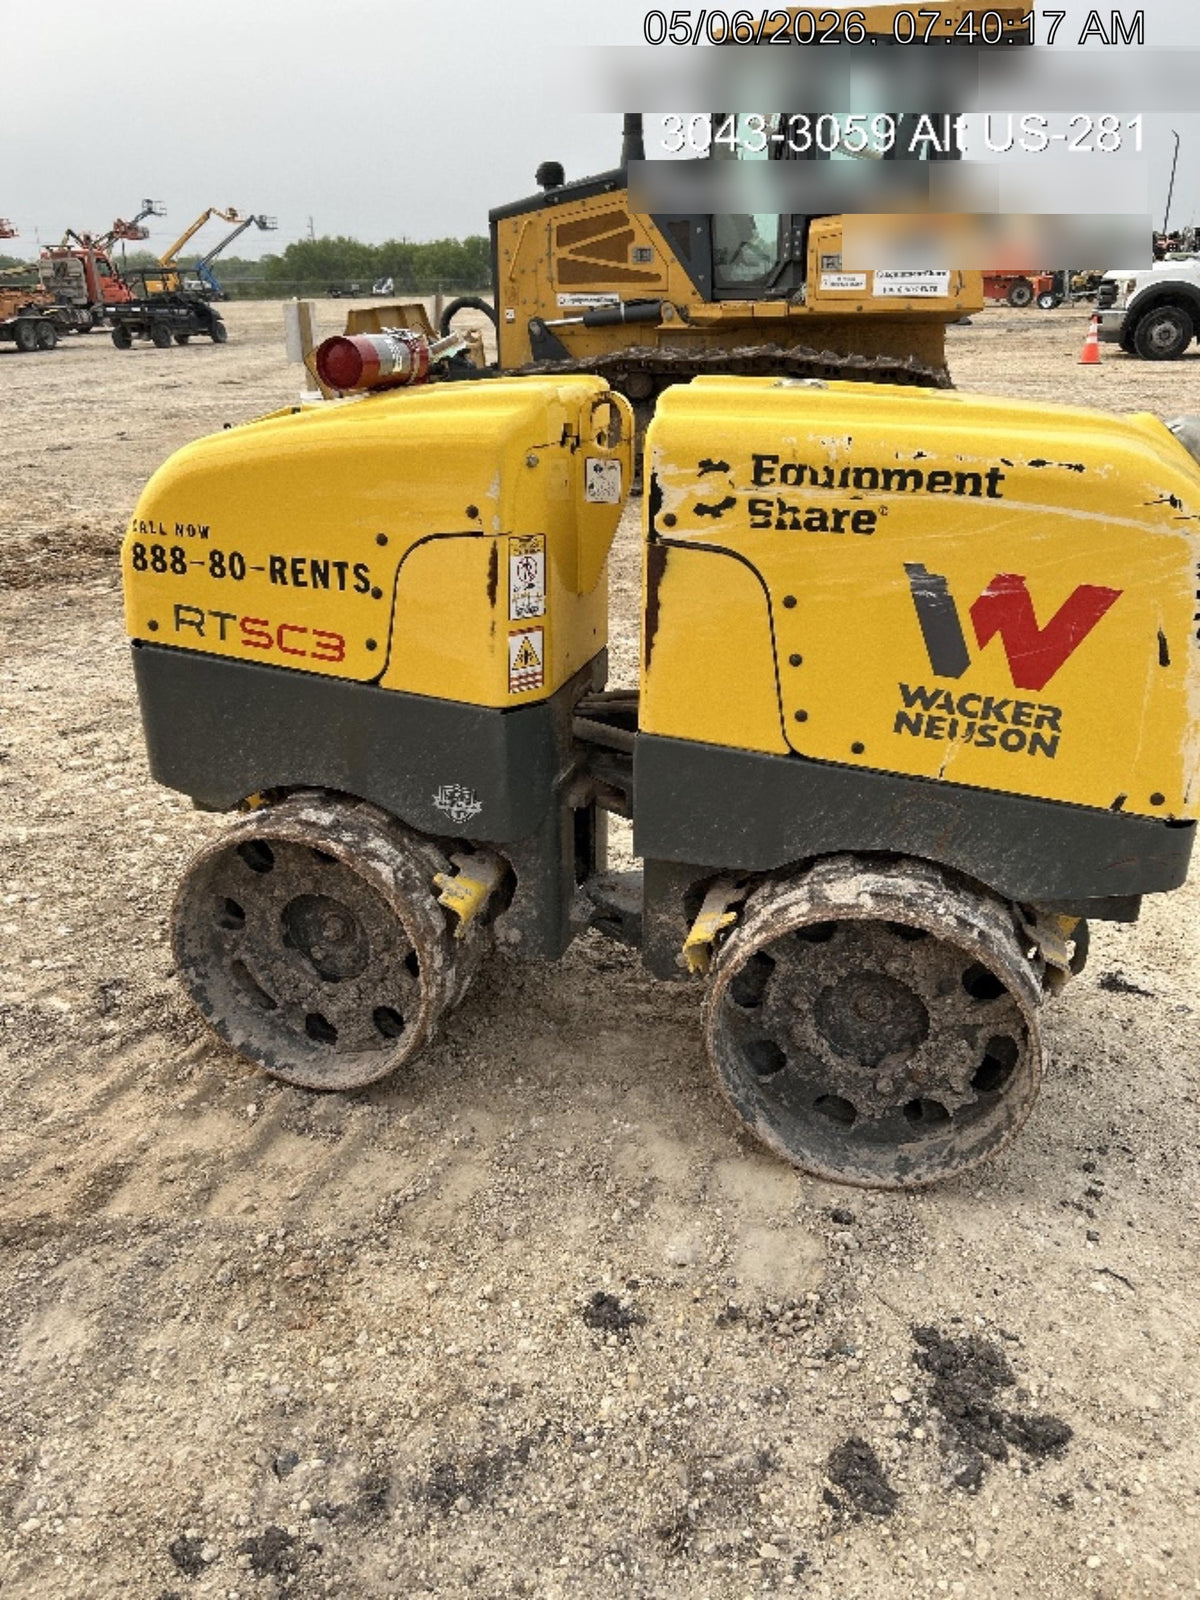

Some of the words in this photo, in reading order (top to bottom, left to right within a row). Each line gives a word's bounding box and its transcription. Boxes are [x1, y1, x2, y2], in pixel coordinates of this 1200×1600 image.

[751, 453, 1005, 498] Equipment
[175, 522, 210, 540] NOW
[173, 603, 346, 663] RTSC3
[898, 682, 1062, 732] WACKER
[893, 711, 1060, 759] NEUSON
